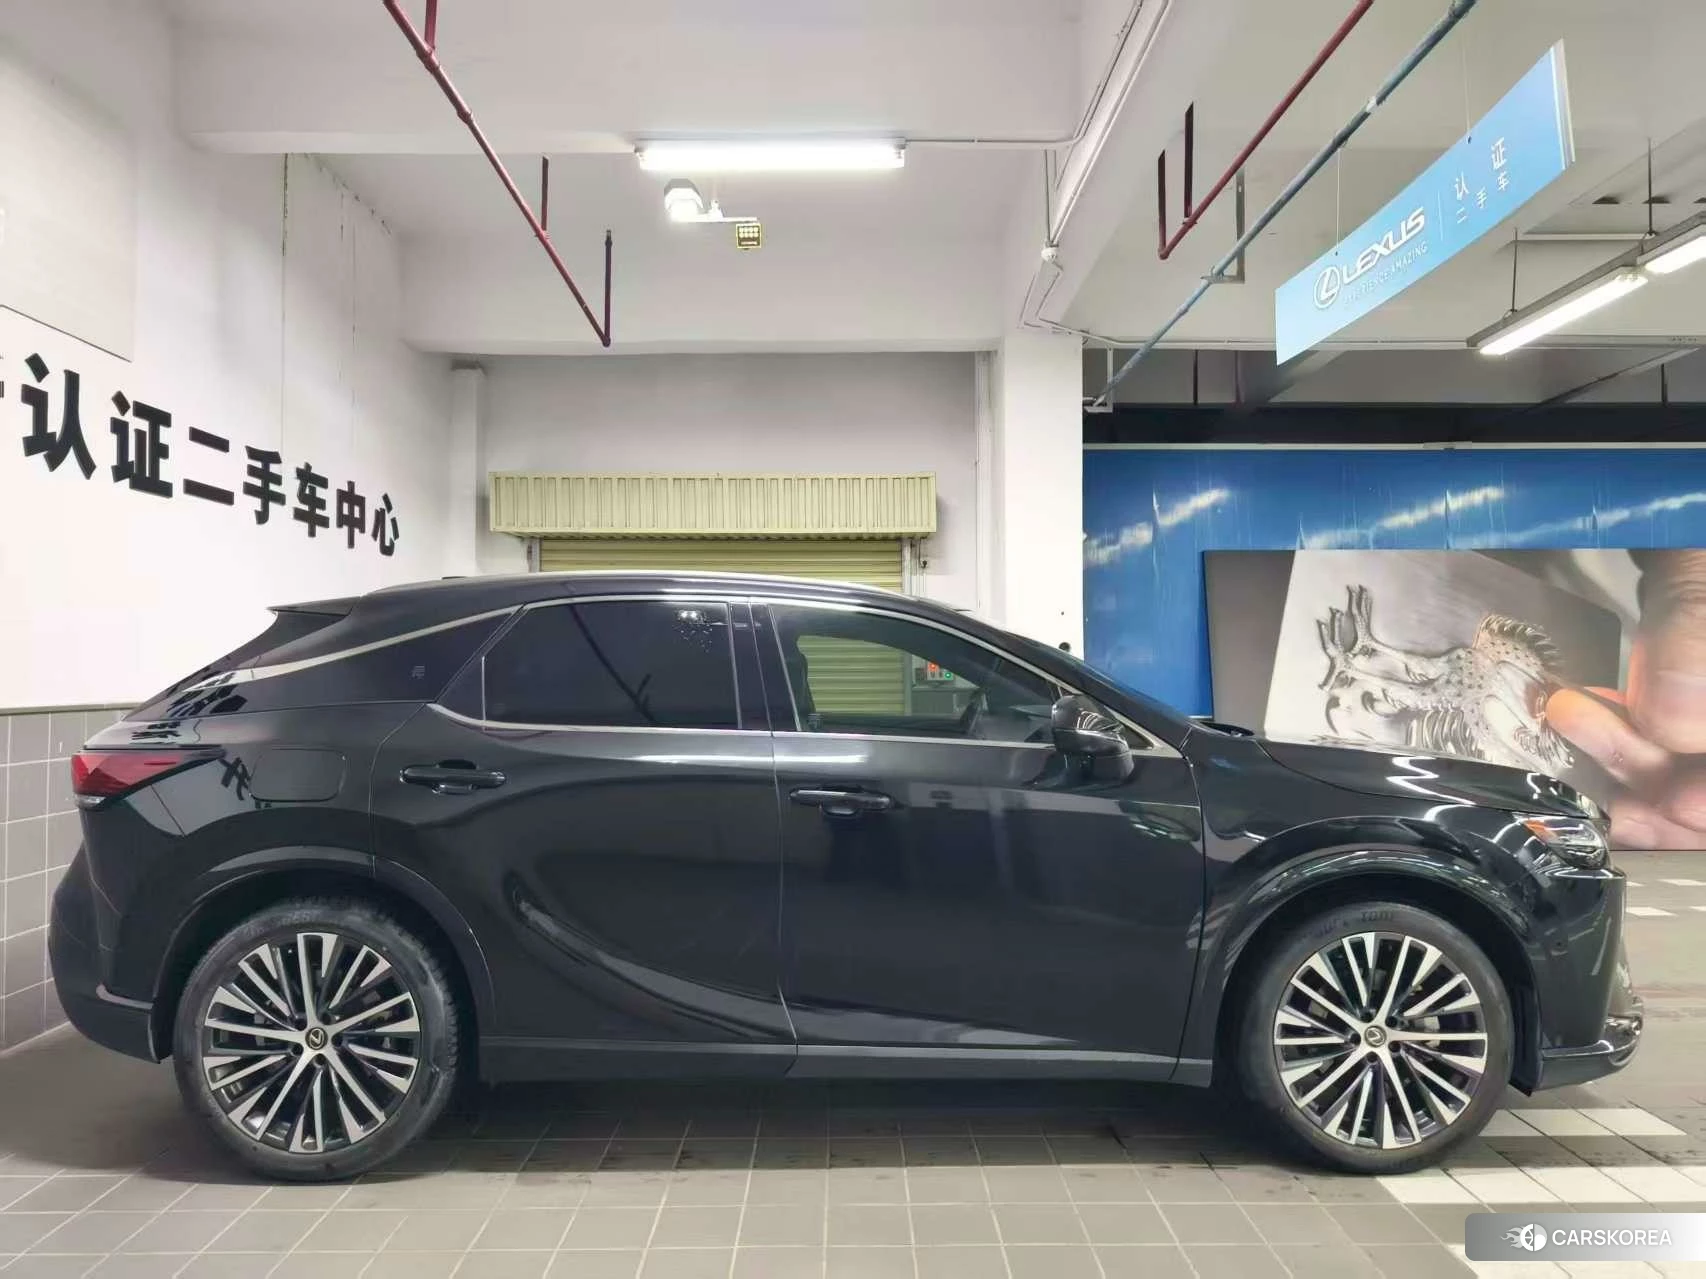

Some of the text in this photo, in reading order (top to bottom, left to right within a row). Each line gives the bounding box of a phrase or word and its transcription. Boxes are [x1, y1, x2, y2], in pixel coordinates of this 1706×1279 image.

[1454, 137, 1507, 201] 认证
[1456, 171, 1510, 224] 二手车
[1342, 206, 1425, 285] LEXUS
[0, 353, 400, 556] 认证二手车中心
